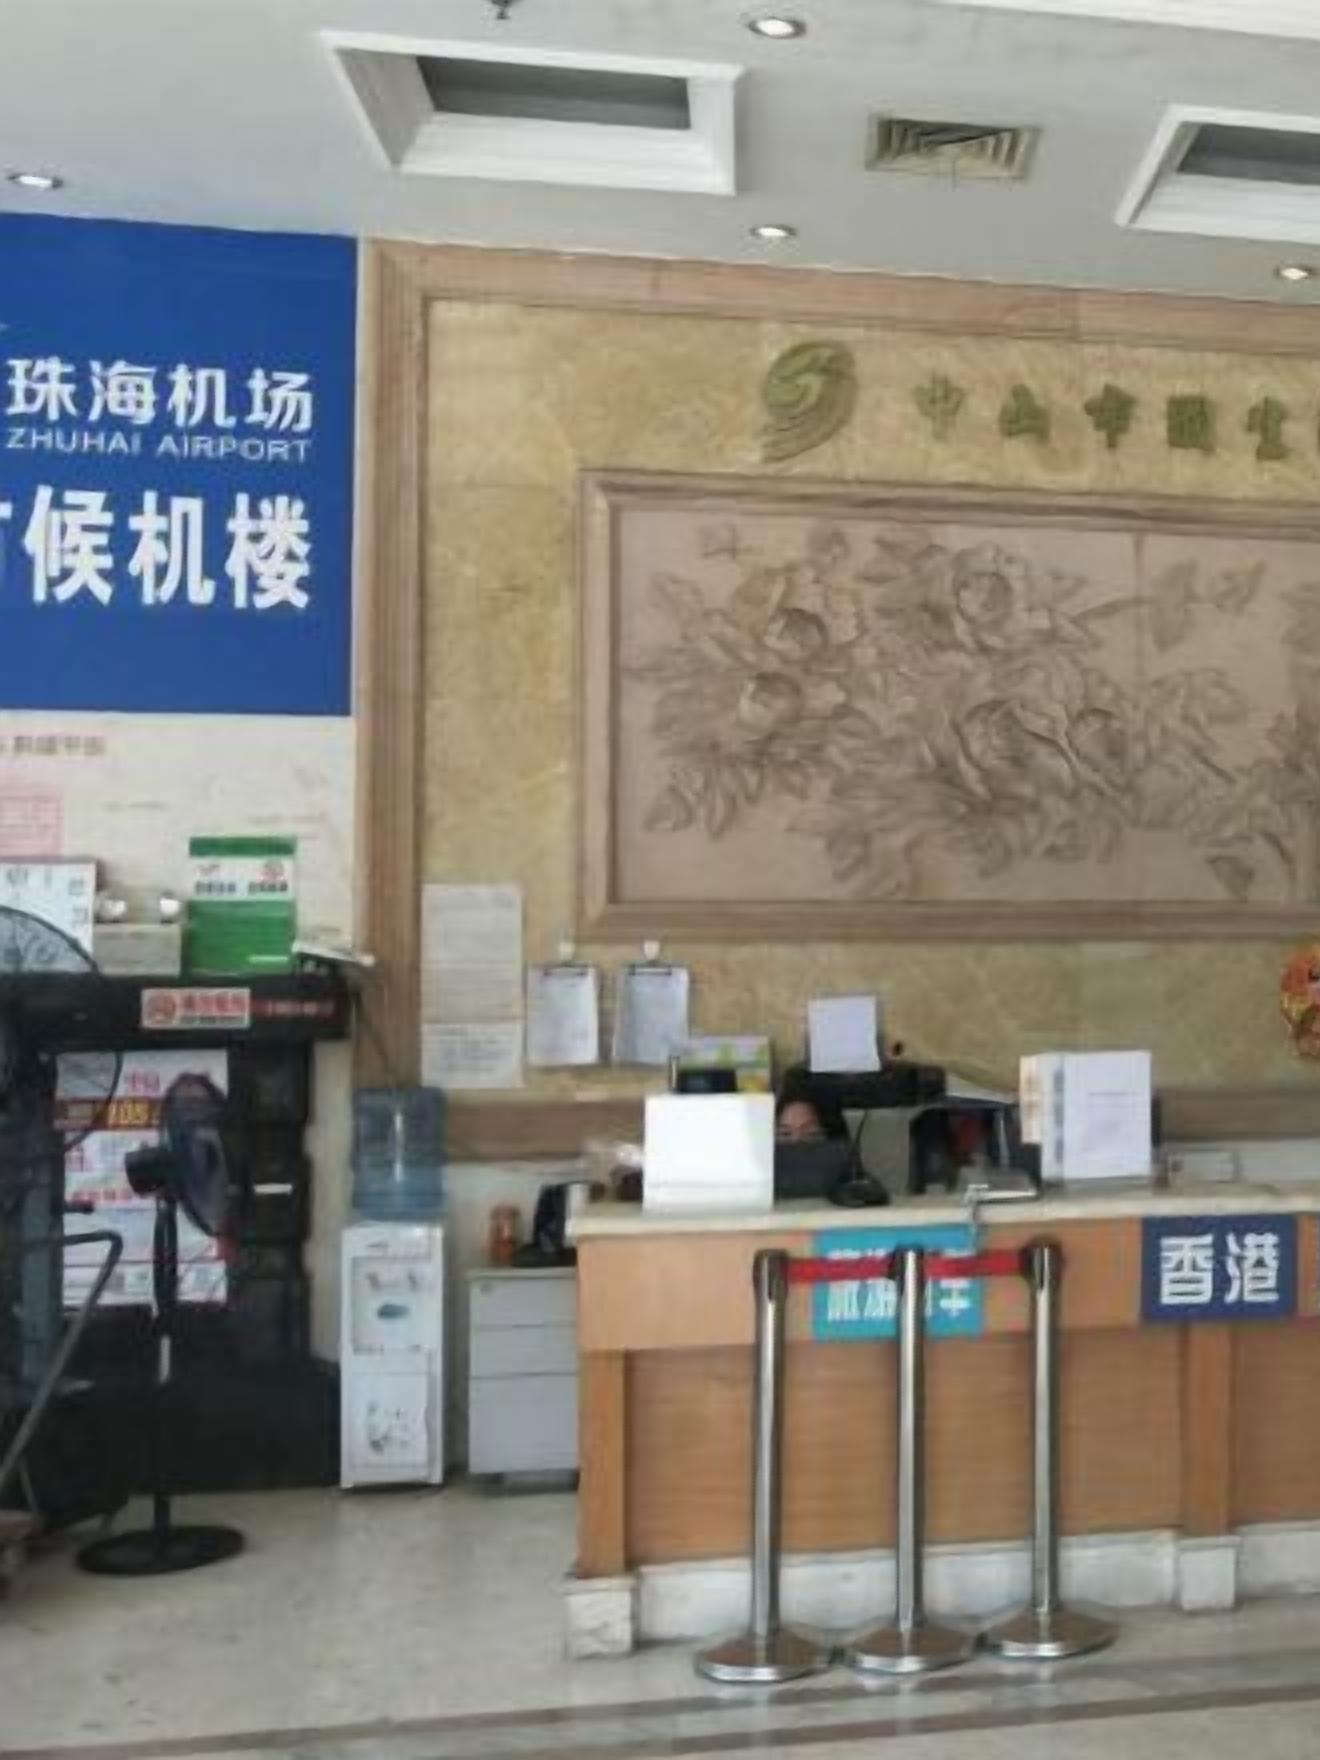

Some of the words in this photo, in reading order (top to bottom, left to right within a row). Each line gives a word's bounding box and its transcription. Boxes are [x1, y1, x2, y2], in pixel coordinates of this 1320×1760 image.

[5, 355, 313, 432] 珠海机场
[6, 428, 141, 455] ZHUHAI
[156, 434, 311, 463] AIRPORT
[0, 484, 311, 609] 候机楼
[1159, 1231, 1281, 1307] 香港
